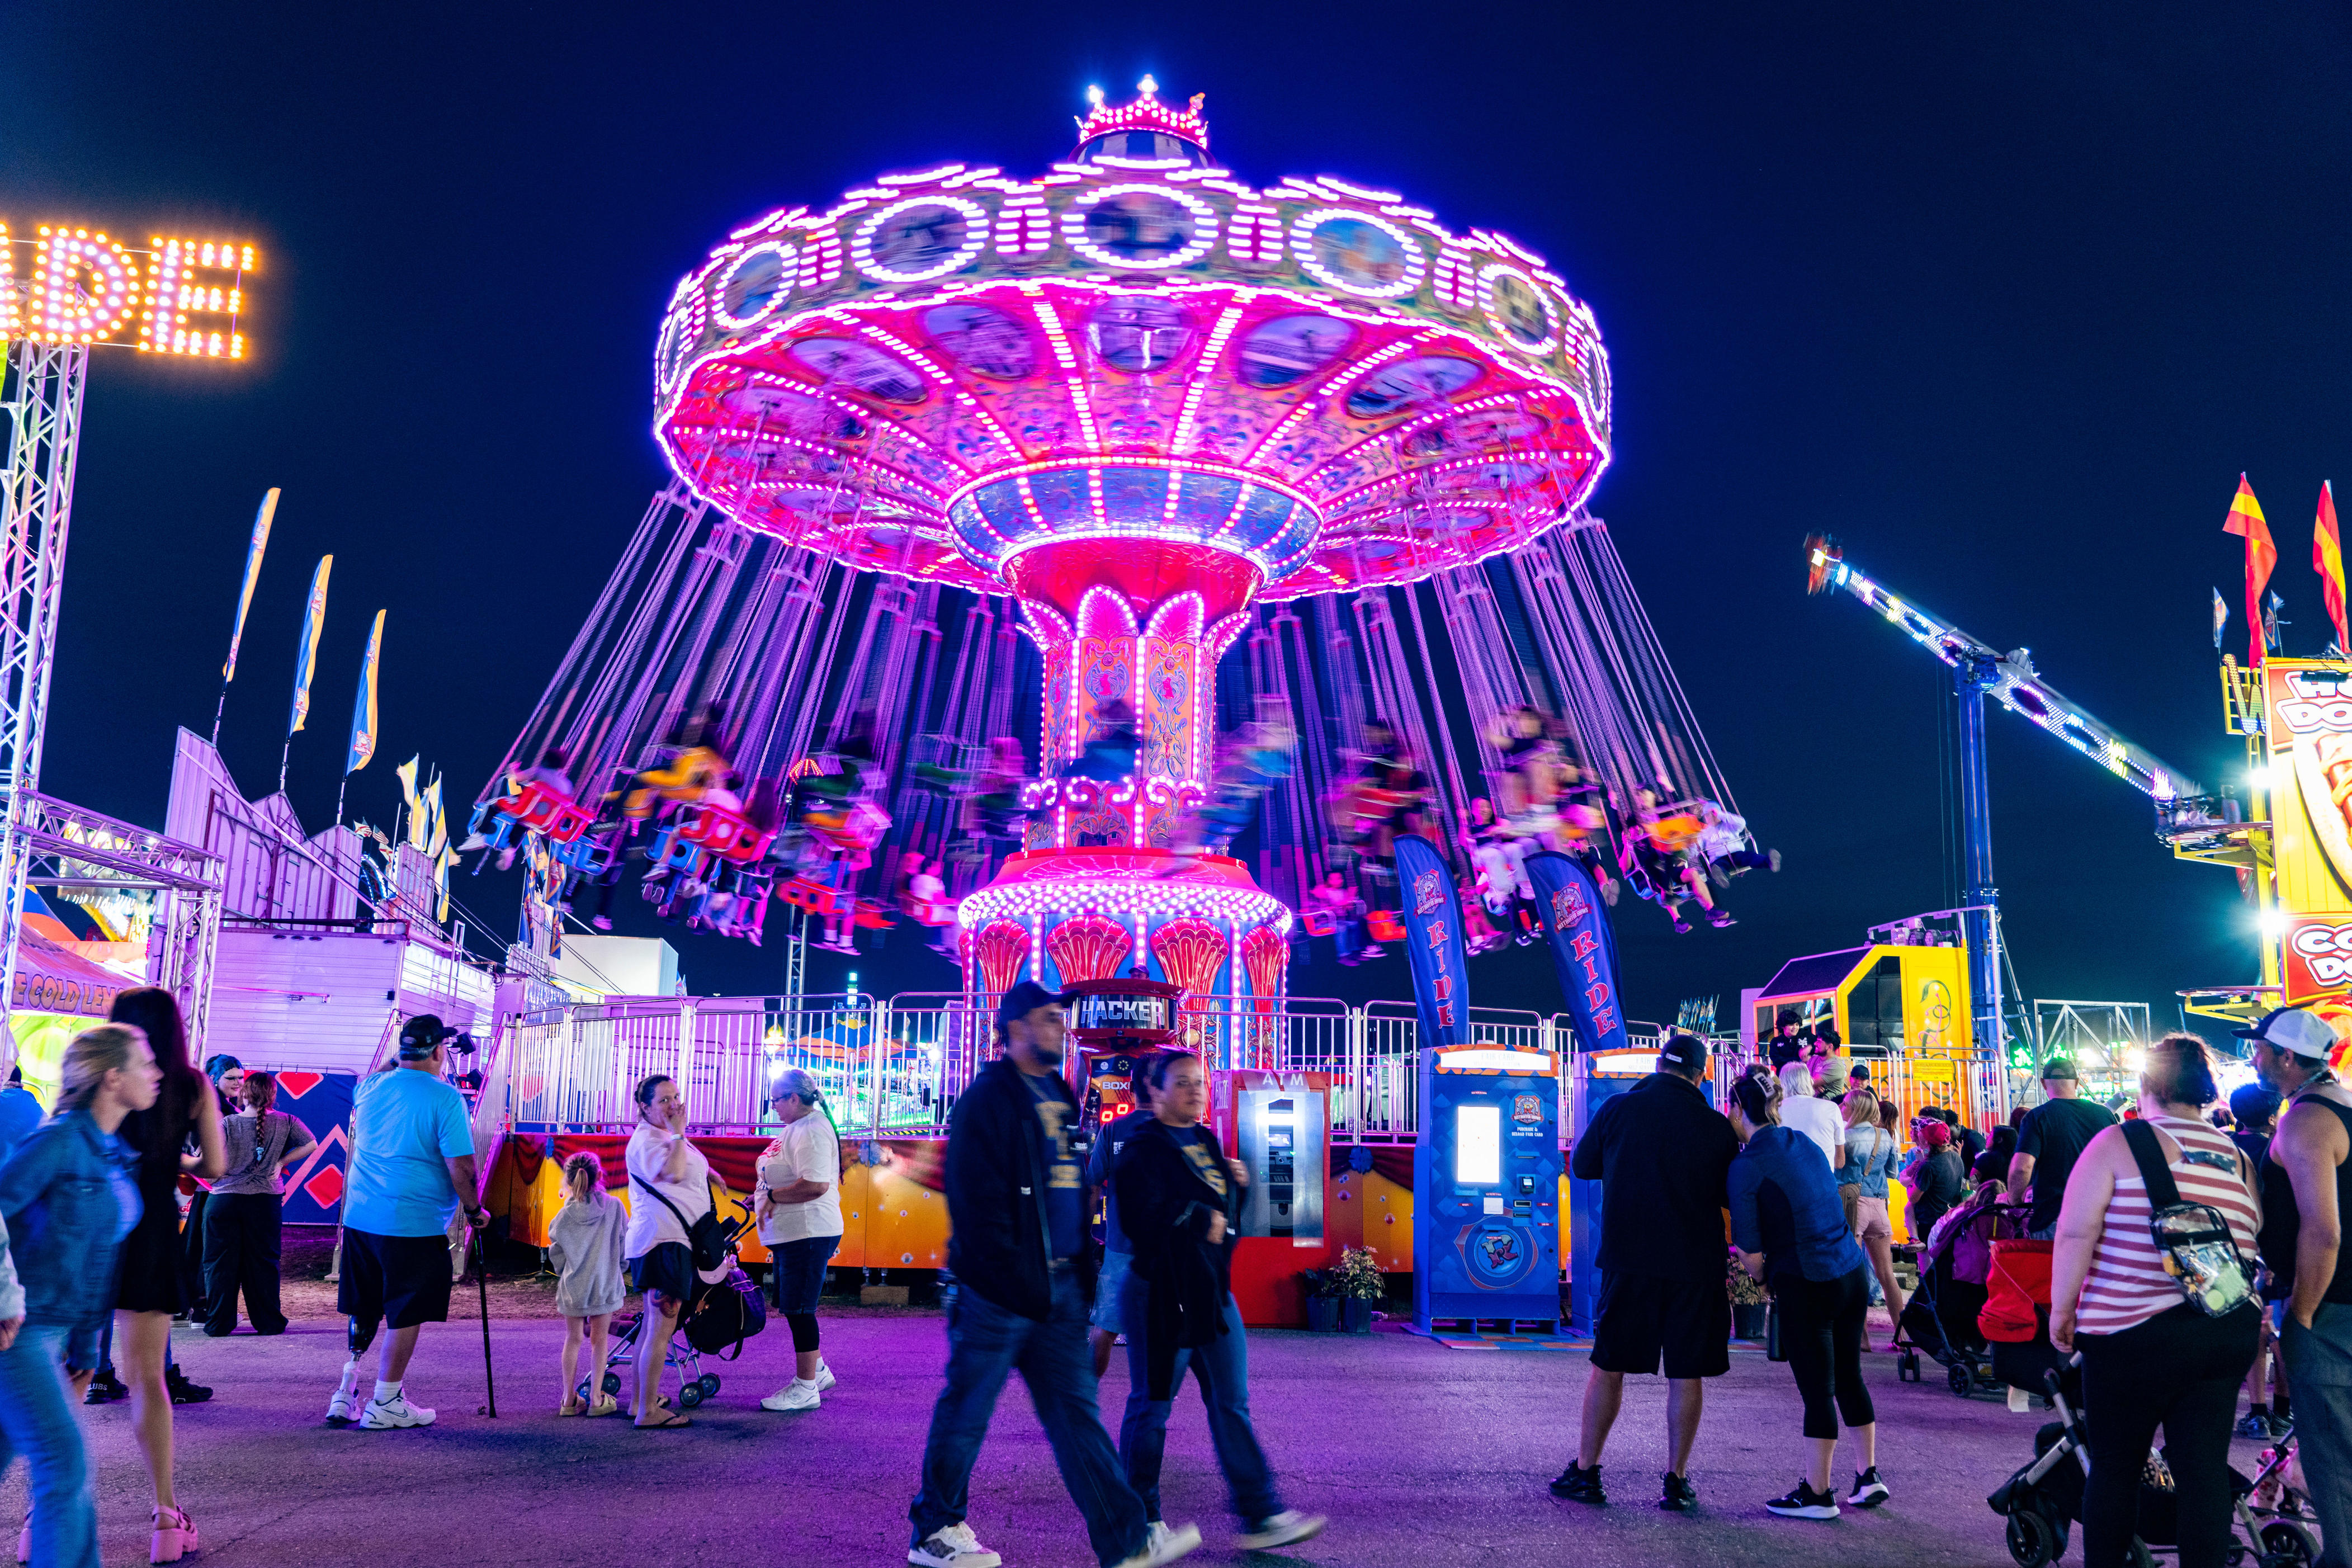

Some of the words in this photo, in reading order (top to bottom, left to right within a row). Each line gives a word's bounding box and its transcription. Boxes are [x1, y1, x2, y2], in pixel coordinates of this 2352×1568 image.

[0, 222, 255, 359] DE
[1427, 921, 1454, 1029] RIDE
[1570, 931, 1617, 1038] RIDE
[2308, 955, 2352, 983] D
[29, 974, 81, 1012] COLD
[81, 983, 124, 1016] LEM
[1081, 1001, 1164, 1026] HACKER
[1263, 1073, 1303, 1085] ATM
